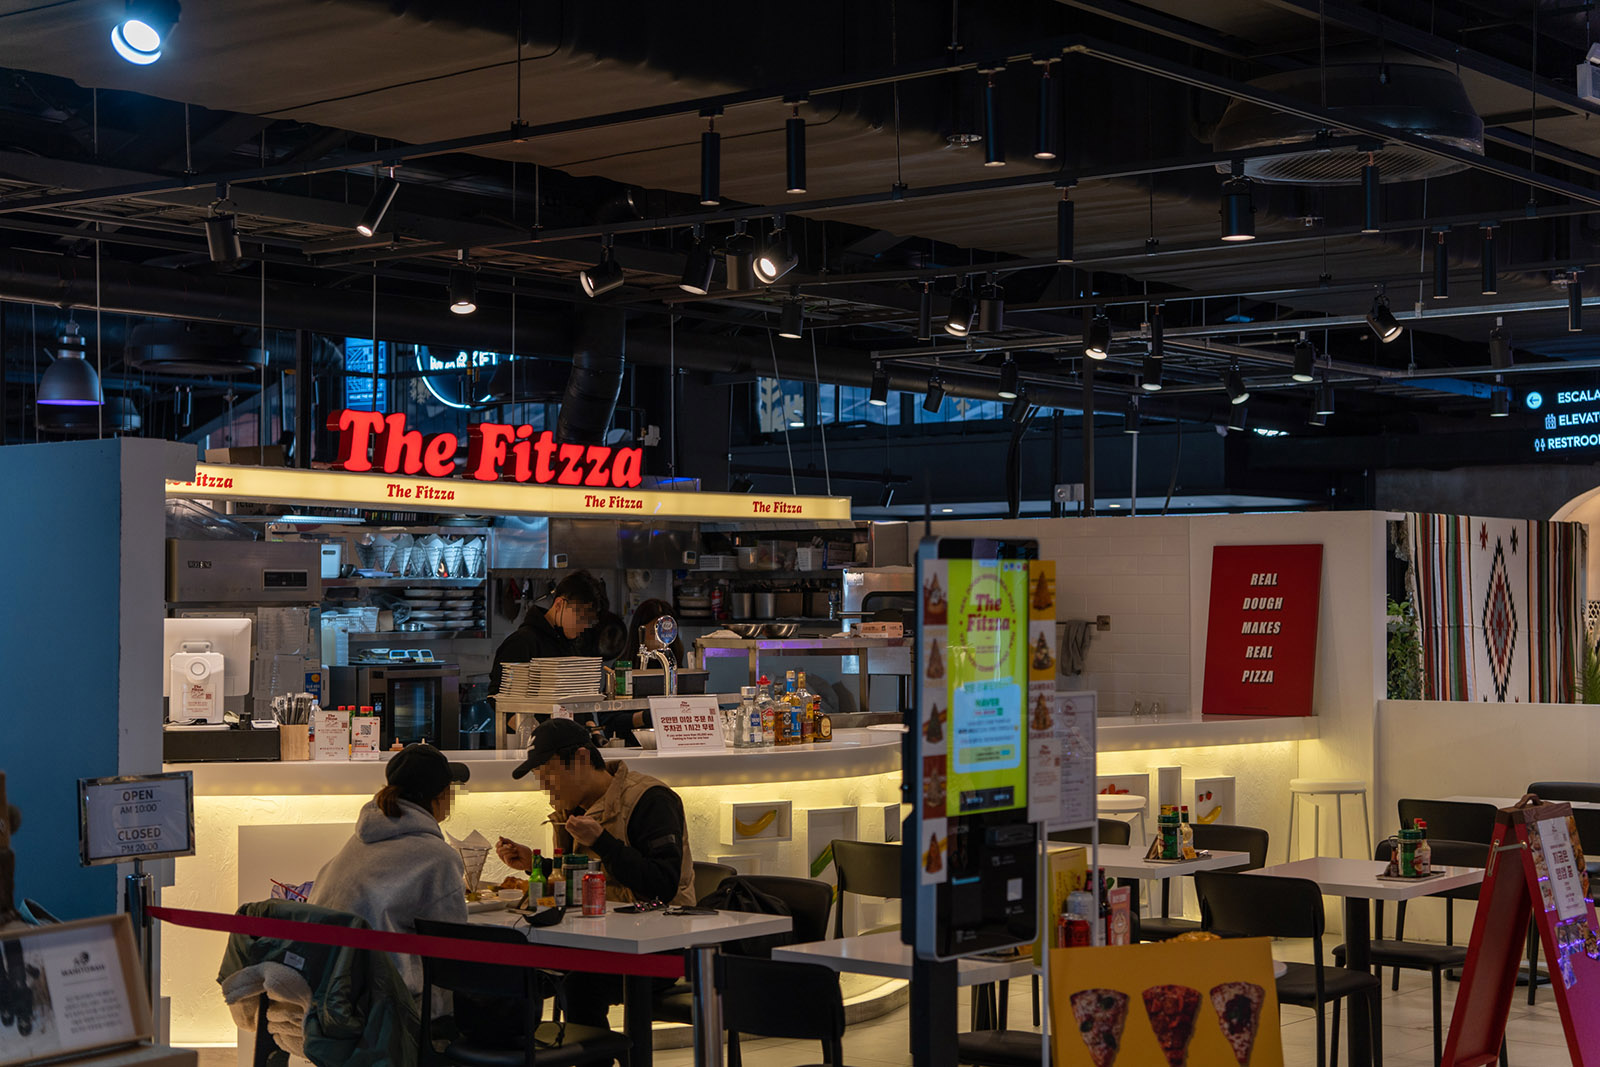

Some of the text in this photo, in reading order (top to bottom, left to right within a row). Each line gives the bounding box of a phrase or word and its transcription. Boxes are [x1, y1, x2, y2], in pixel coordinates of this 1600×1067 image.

[1558, 411, 1600, 426] ELEVAT
[339, 408, 643, 488] The Fitzza
[1547, 433, 1600, 450] RESTROO
[185, 471, 233, 489] itzza
[386, 483, 455, 501] The Fitzza
[584, 494, 643, 510] The Fitzza
[752, 500, 803, 514] The Fitzza
[1250, 573, 1278, 586] REAL
[976, 593, 1002, 612] The
[1242, 597, 1284, 610] DOUGH
[966, 613, 1010, 632] Fitzza
[1241, 621, 1281, 634] MAKES
[1245, 645, 1273, 658] REAL
[1241, 670, 1274, 683] PIZZA
[122, 790, 153, 802] OPEN
[120, 803, 157, 814] AM 10:00
[118, 827, 161, 841] CLOSED
[121, 842, 158, 853] PM 20:00
